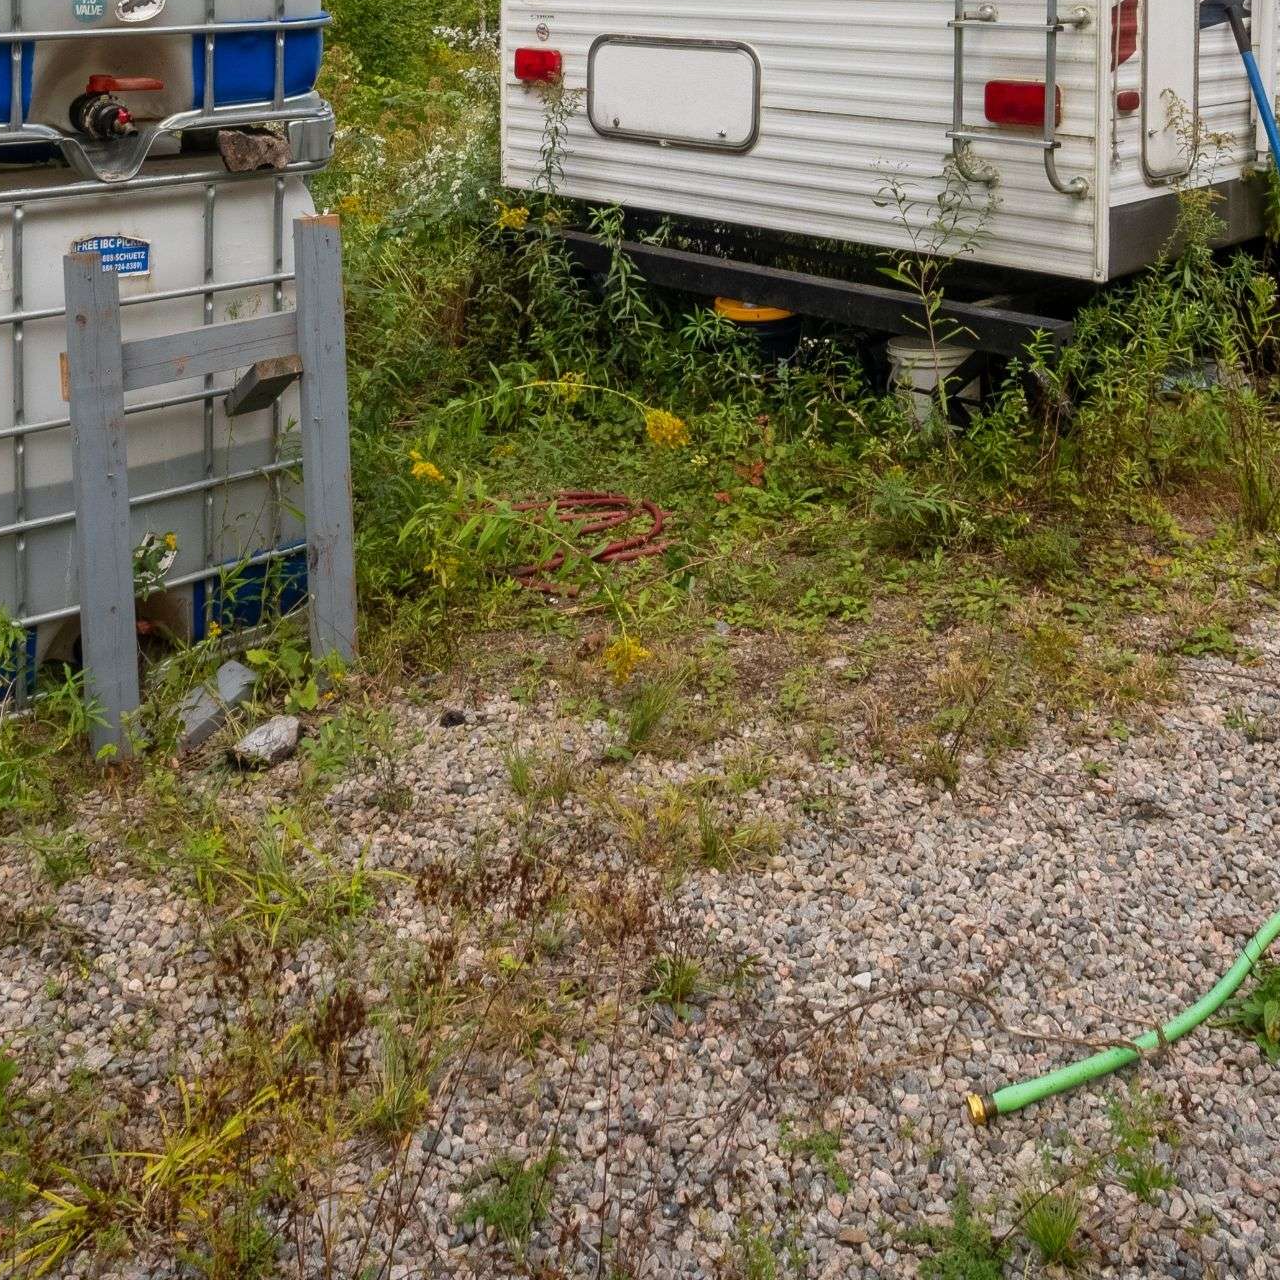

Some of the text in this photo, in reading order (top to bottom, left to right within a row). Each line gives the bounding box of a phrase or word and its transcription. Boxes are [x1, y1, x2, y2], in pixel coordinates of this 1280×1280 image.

[74, 4, 103, 16] VALVE
[77, 240, 99, 252] FREE
[100, 238, 115, 250] IBC
